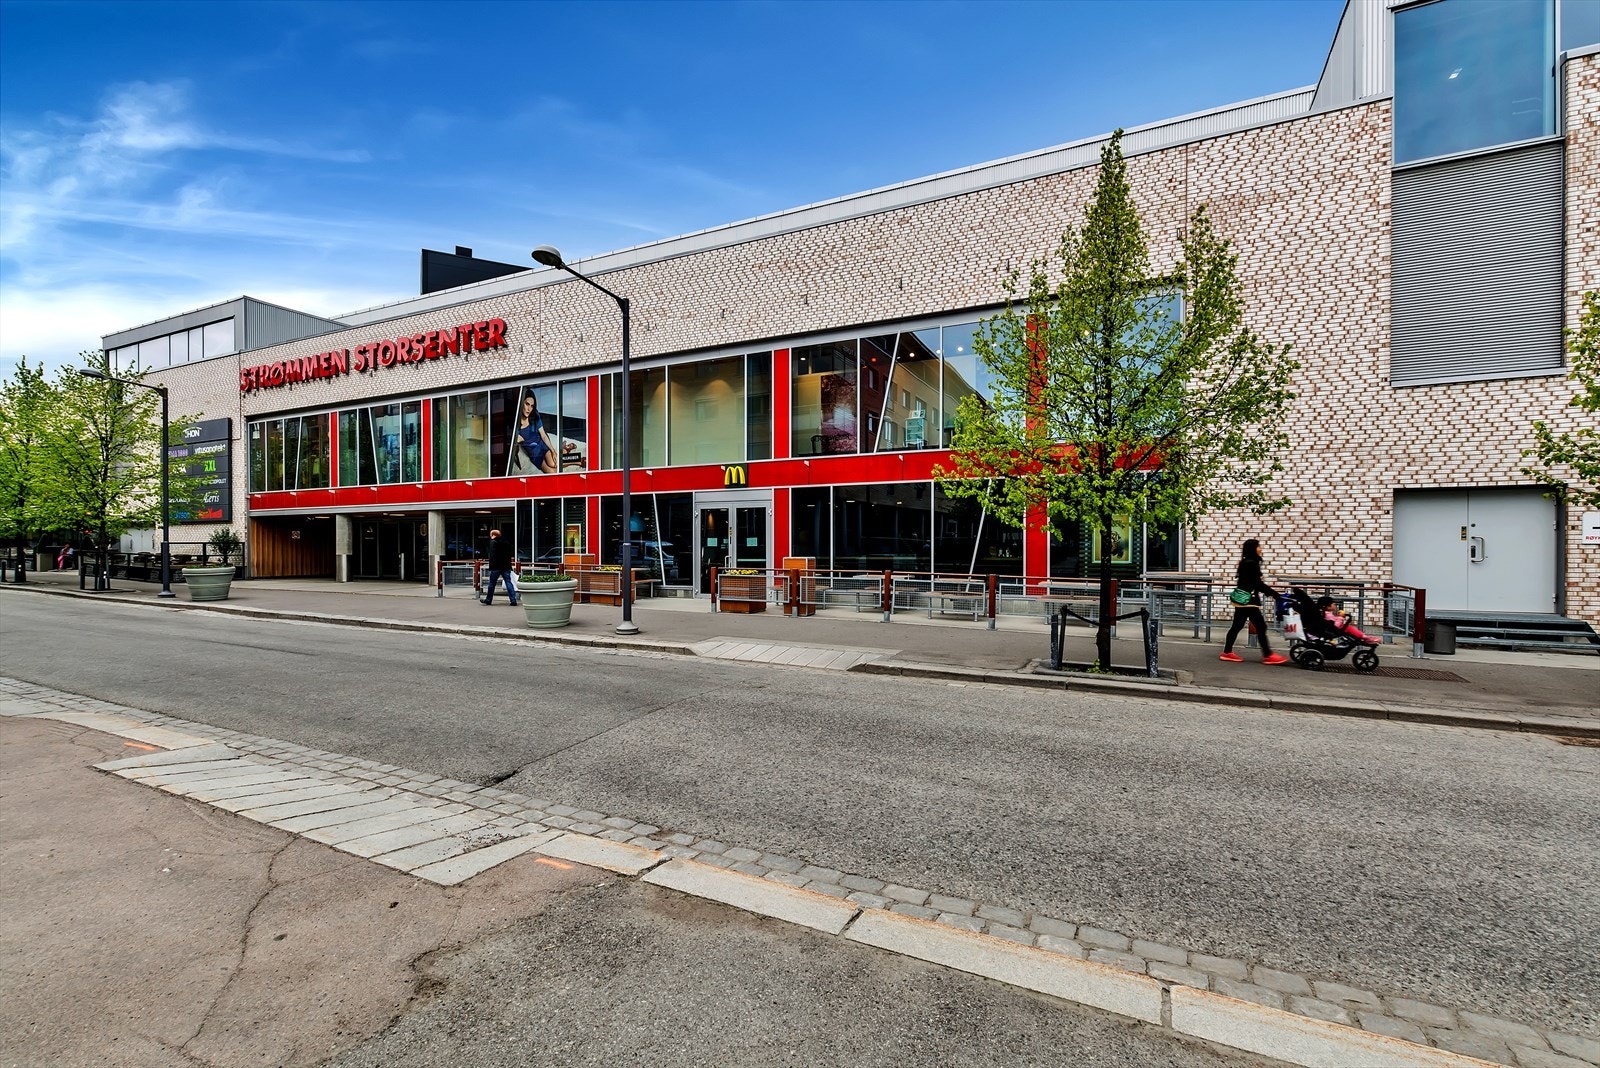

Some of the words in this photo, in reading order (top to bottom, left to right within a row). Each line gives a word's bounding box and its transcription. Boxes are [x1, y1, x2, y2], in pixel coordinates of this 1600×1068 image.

[240, 348, 348, 391] STRØMMEN
[354, 318, 507, 371] STORSENTER
[205, 460, 216, 472] XXL
